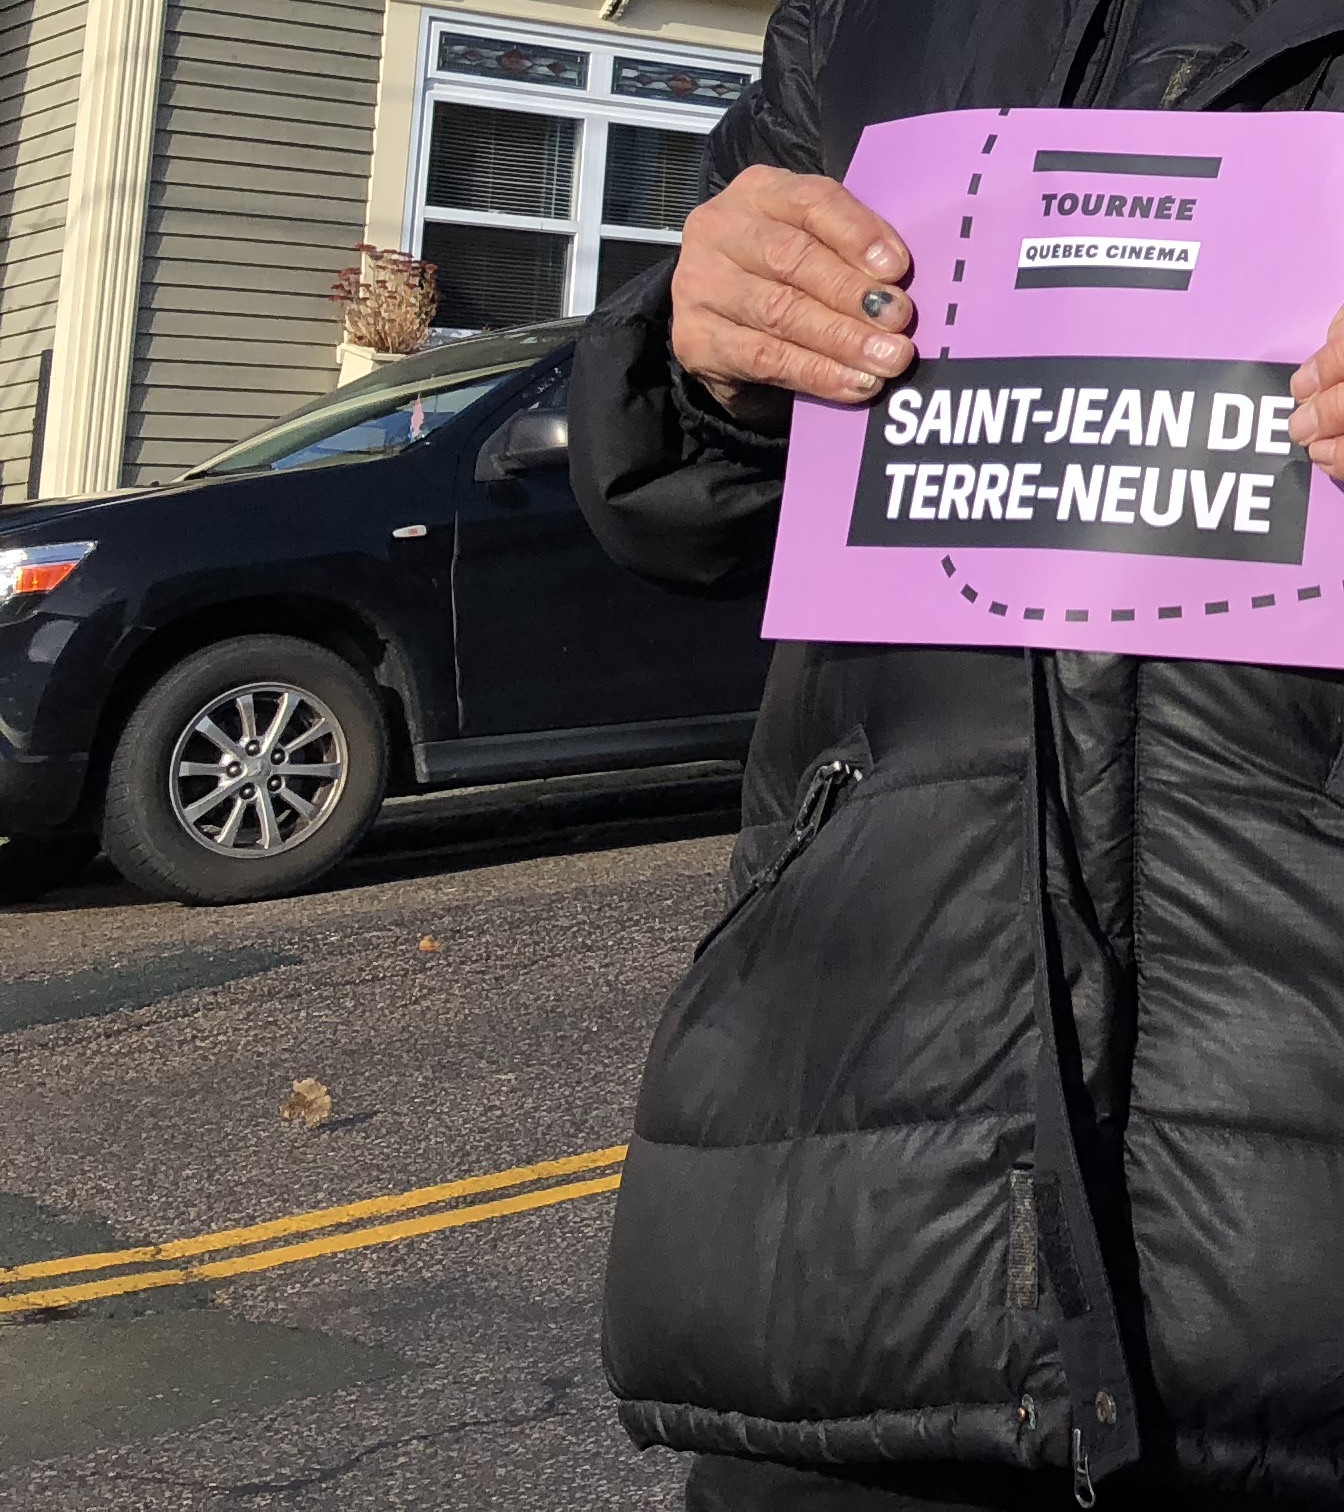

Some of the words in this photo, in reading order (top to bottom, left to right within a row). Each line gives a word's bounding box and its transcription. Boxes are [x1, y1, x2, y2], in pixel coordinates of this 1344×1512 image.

[1041, 192, 1198, 221] TOURNÉE
[1025, 243, 1099, 262] QUÉBEC
[1105, 244, 1190, 263] CINÉMA
[883, 387, 1196, 448] SAINT-JEAN
[1206, 391, 1296, 455] DE
[884, 462, 1275, 534] TERRE-NEUVE
